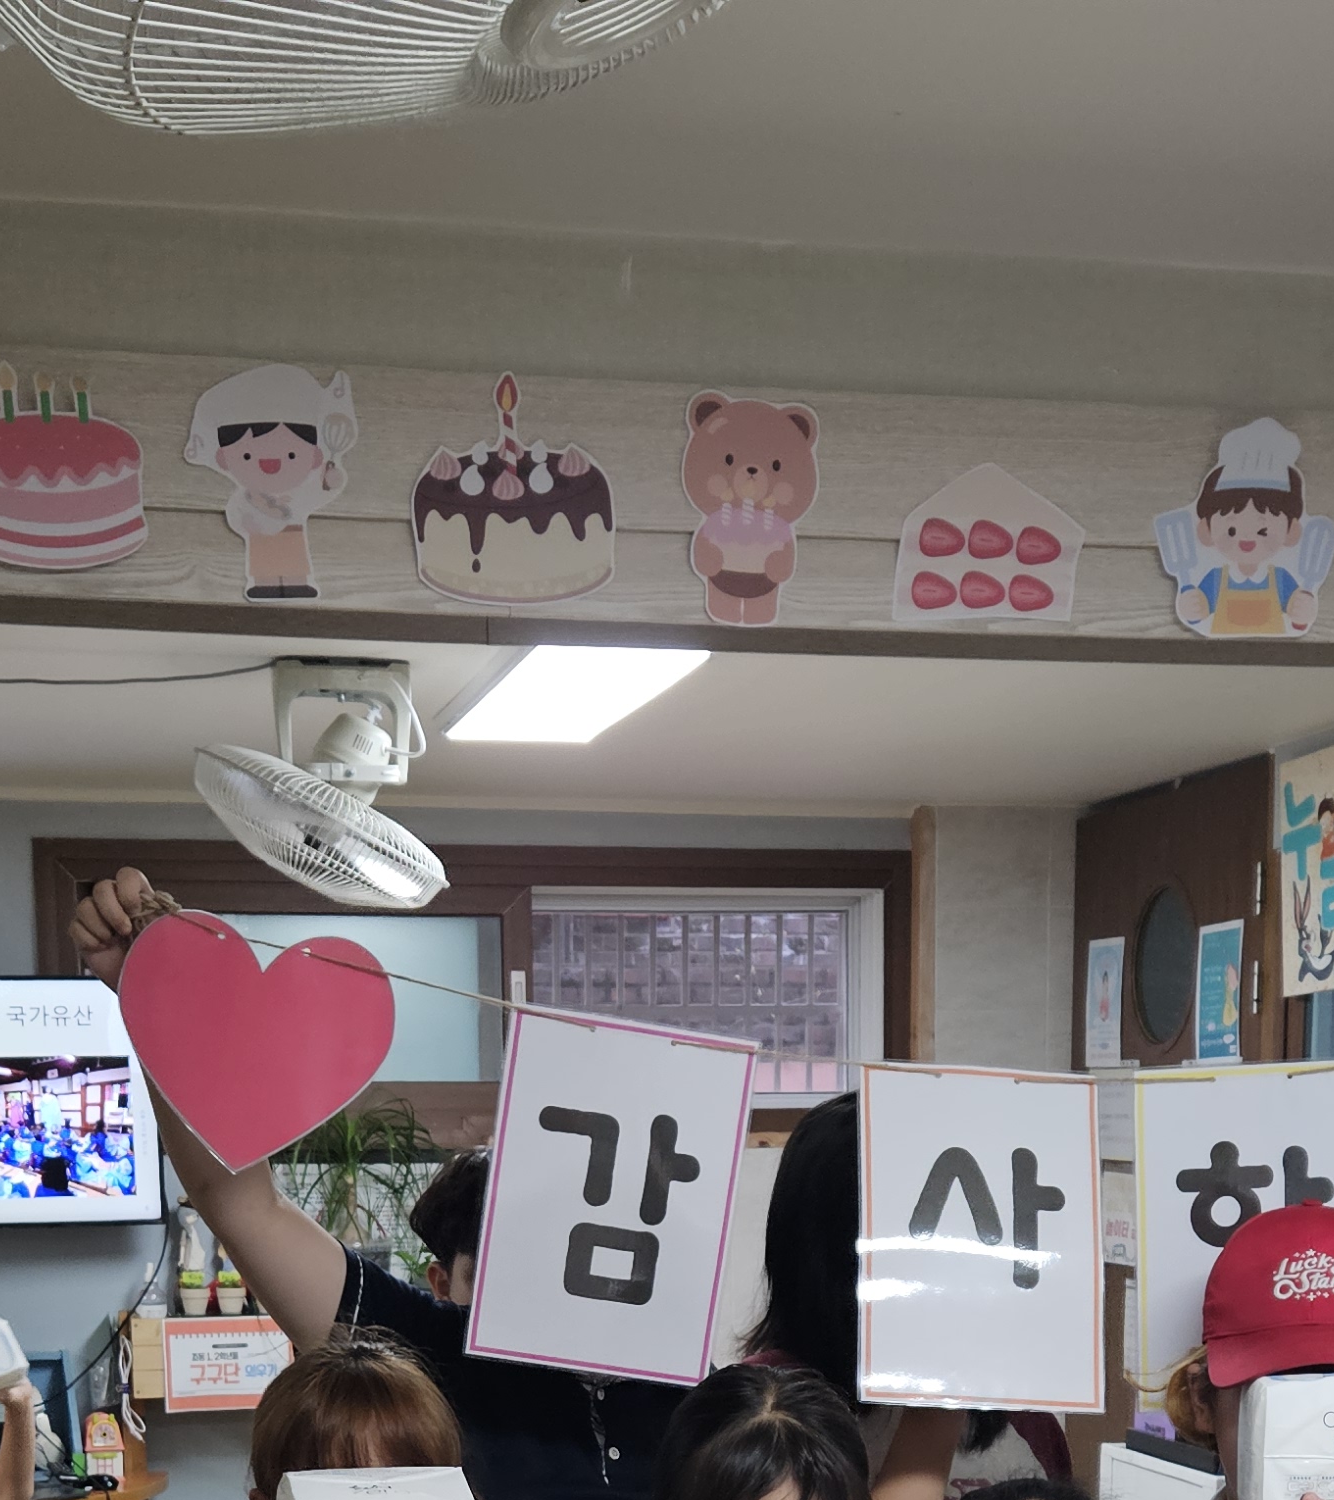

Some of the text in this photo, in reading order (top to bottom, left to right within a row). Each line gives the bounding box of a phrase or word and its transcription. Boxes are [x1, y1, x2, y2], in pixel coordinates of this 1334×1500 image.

[6, 1005, 93, 1028] 국가유산
[539, 1105, 700, 1305] 감
[908, 1147, 1066, 1289] 사
[190, 1362, 240, 1385] 구구단
